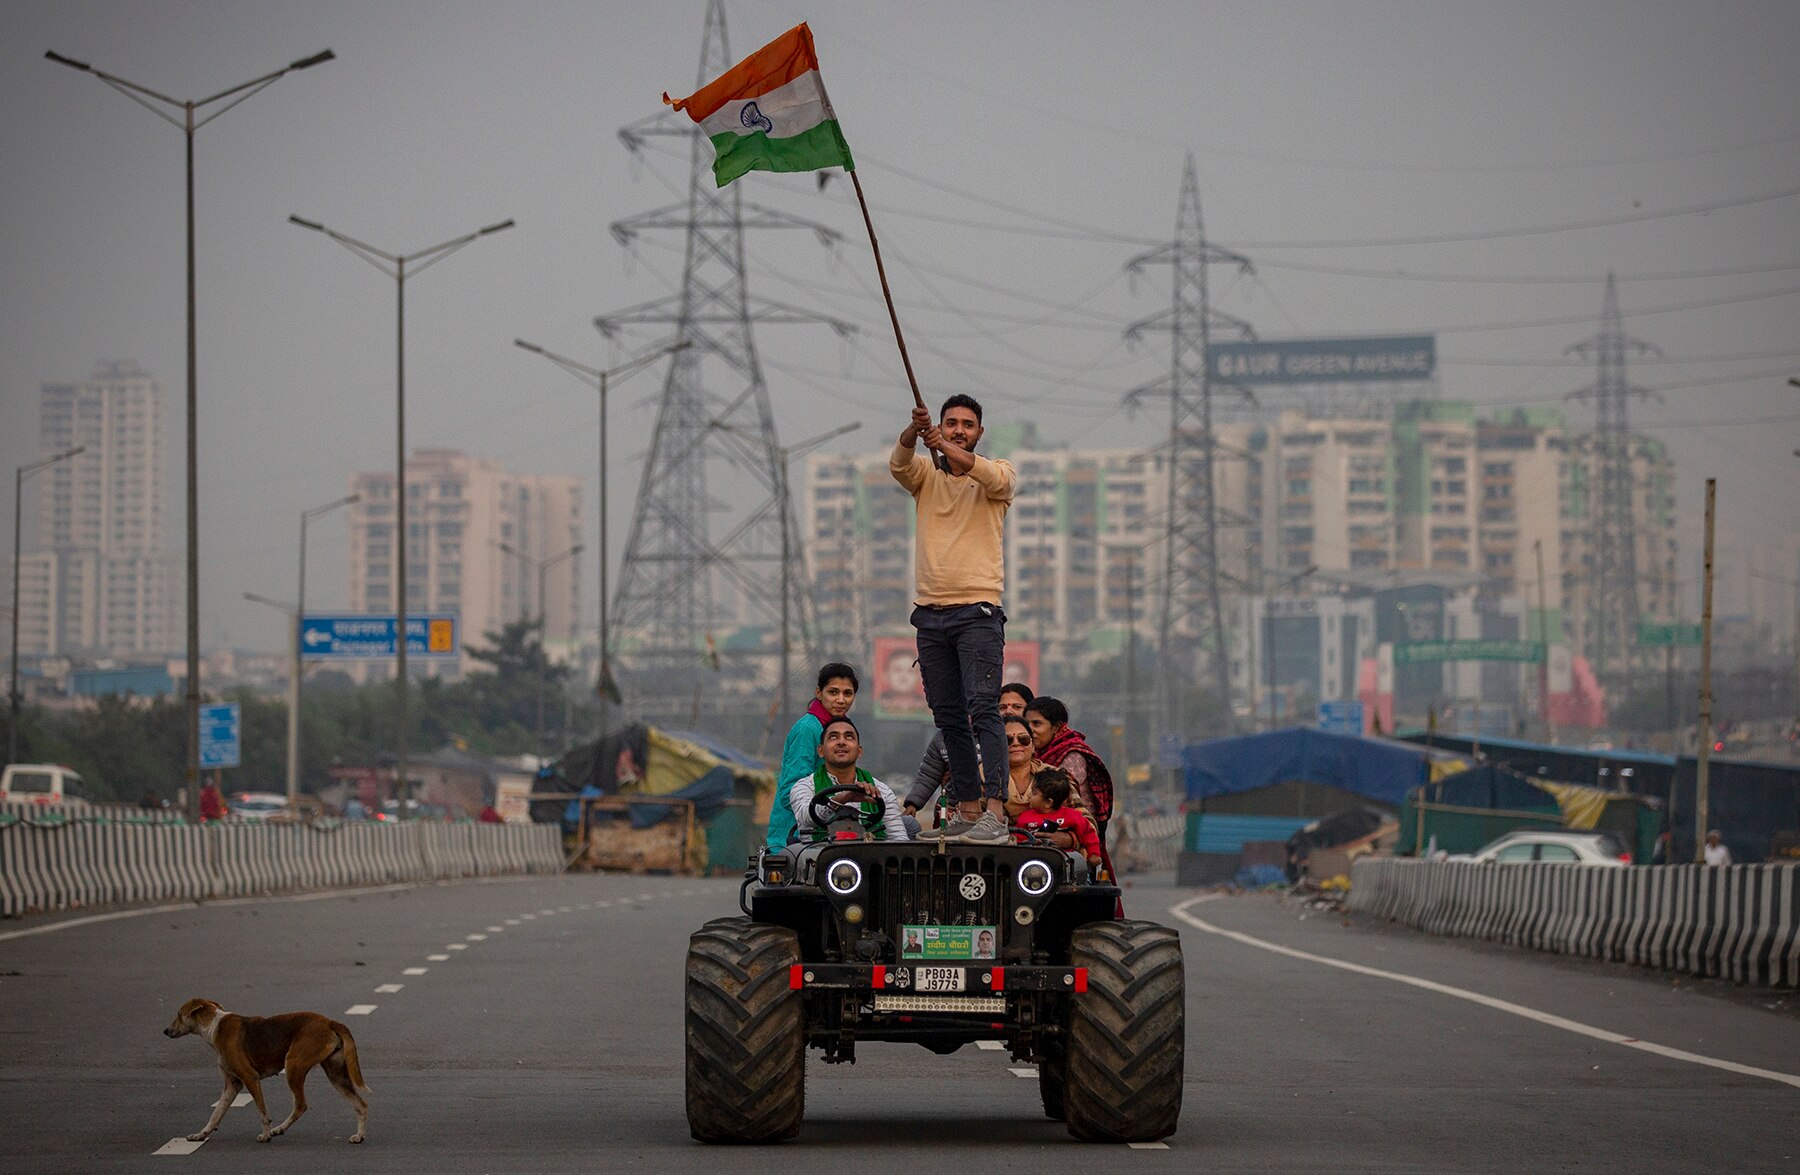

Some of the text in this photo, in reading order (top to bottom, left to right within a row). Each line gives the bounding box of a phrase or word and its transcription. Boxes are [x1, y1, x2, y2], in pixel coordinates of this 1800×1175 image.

[1286, 354, 1352, 376] GREEN
[1354, 350, 1429, 373] AVENUE
[925, 968, 959, 980] PB03A
[924, 979, 958, 990] J9779
